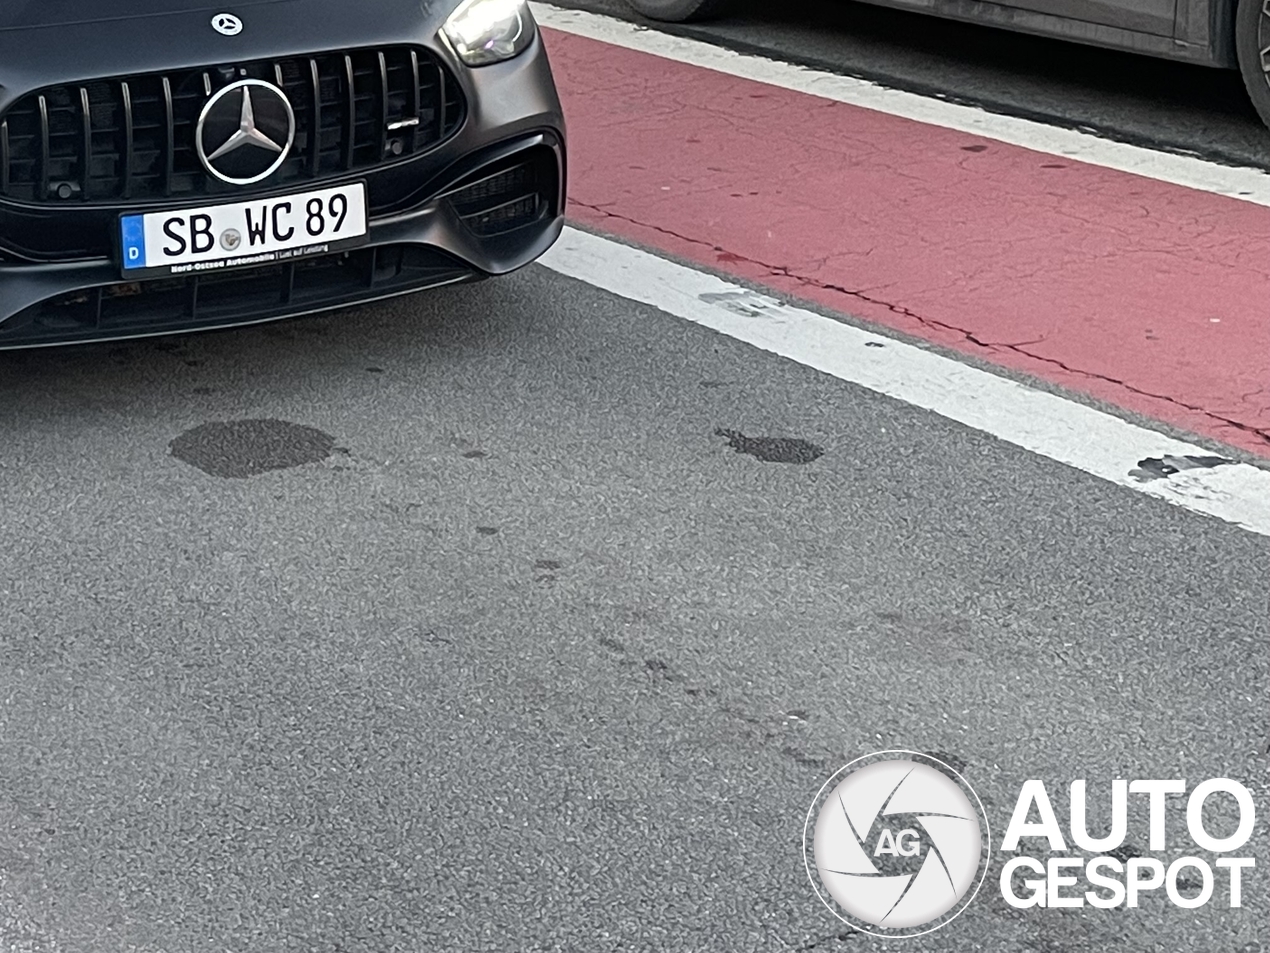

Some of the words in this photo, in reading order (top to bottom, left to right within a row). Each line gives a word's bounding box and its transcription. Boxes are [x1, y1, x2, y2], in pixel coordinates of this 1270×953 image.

[162, 213, 215, 257] SB
[245, 201, 295, 246] WC
[306, 193, 348, 237] 89
